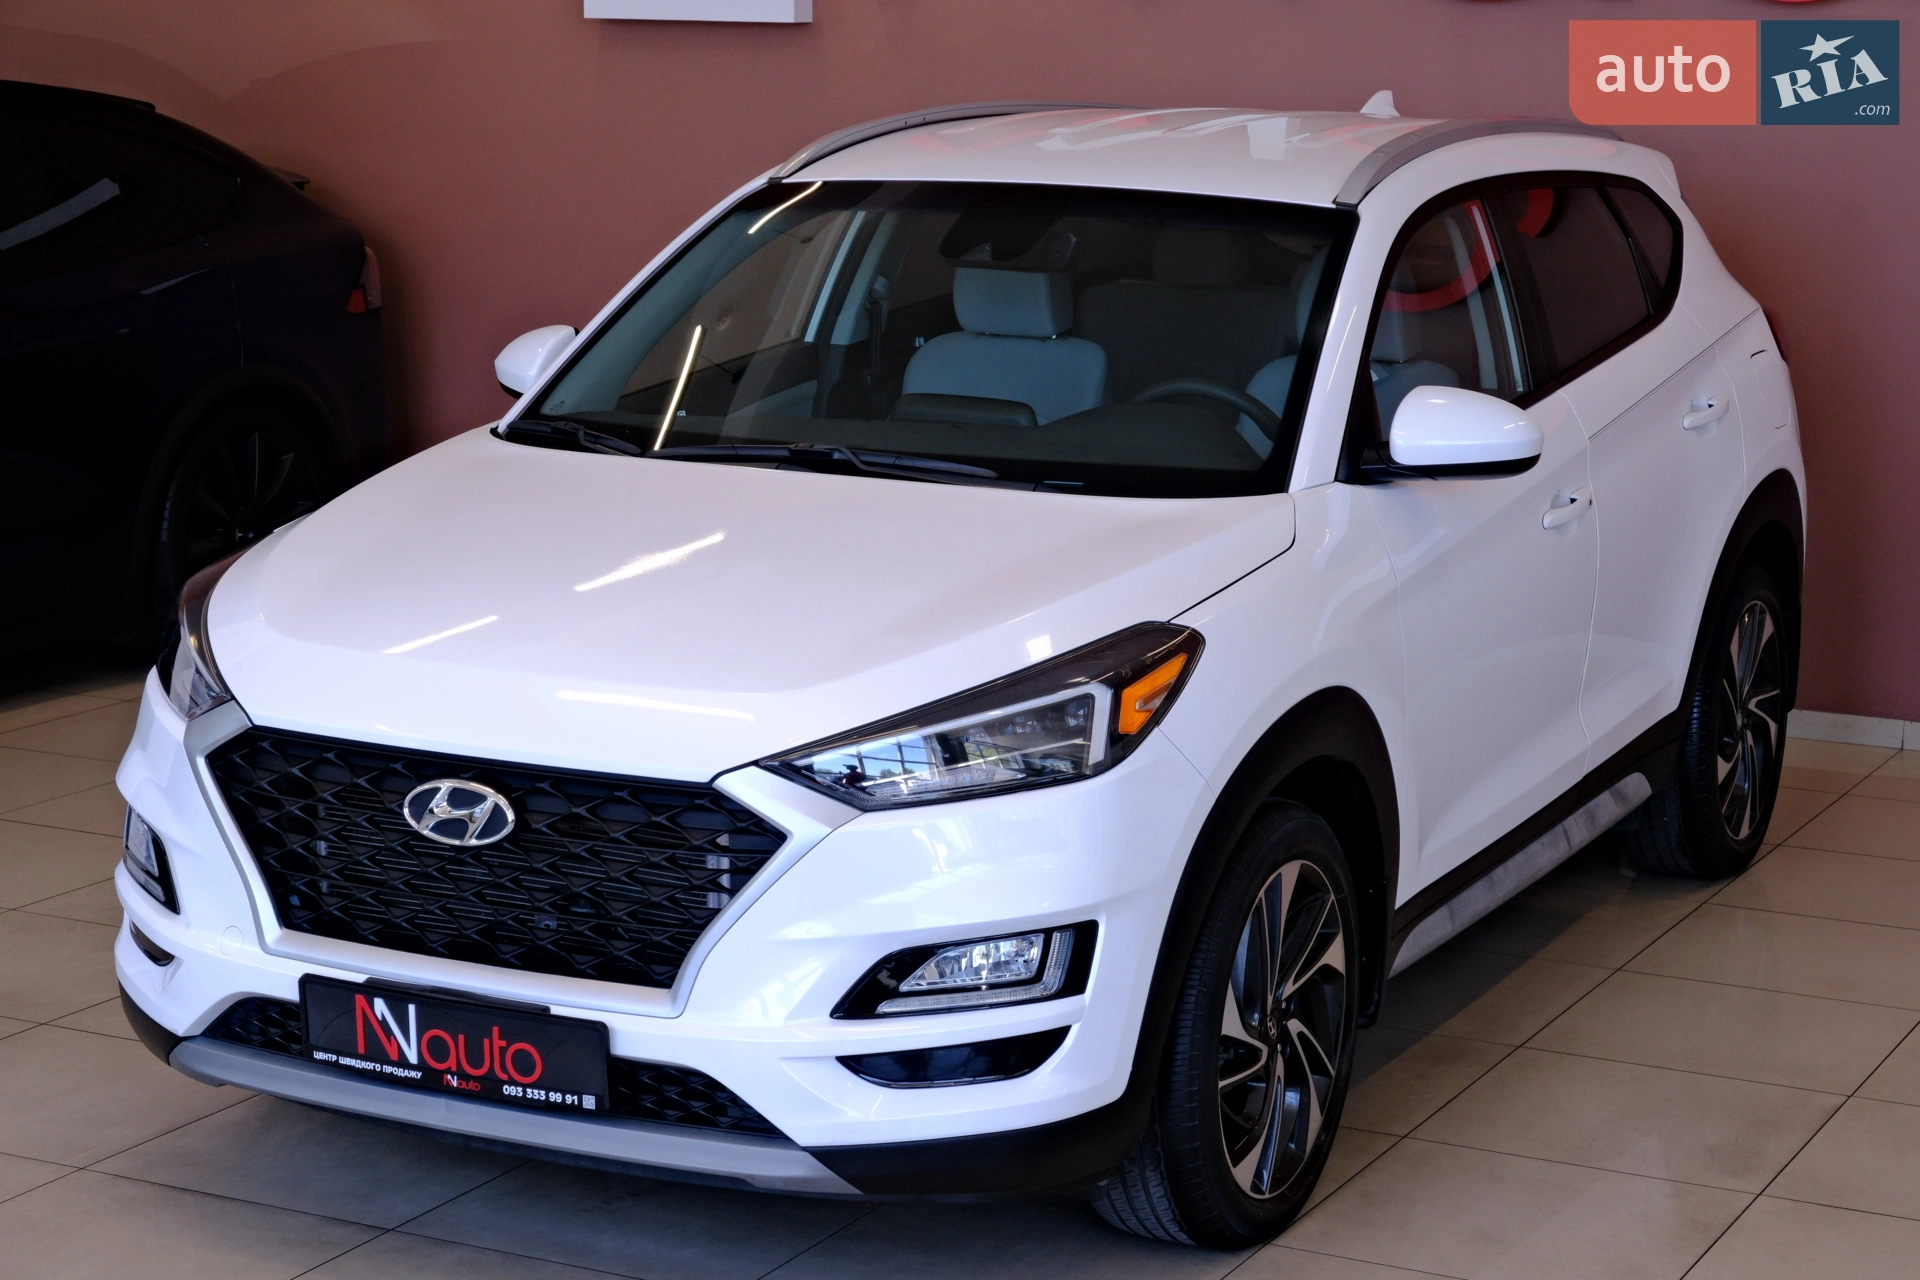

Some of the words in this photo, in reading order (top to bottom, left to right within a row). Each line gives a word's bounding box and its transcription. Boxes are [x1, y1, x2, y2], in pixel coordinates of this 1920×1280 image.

[313, 1051, 337, 1062] ЦЕНТР
[338, 1057, 381, 1072] ШВИДКОГО
[382, 1065, 422, 1079] ПРОДАЖУ
[503, 1085, 523, 1097] 093
[526, 1088, 546, 1100] 333
[548, 1092, 562, 1103] 99
[565, 1094, 578, 1105] 91
